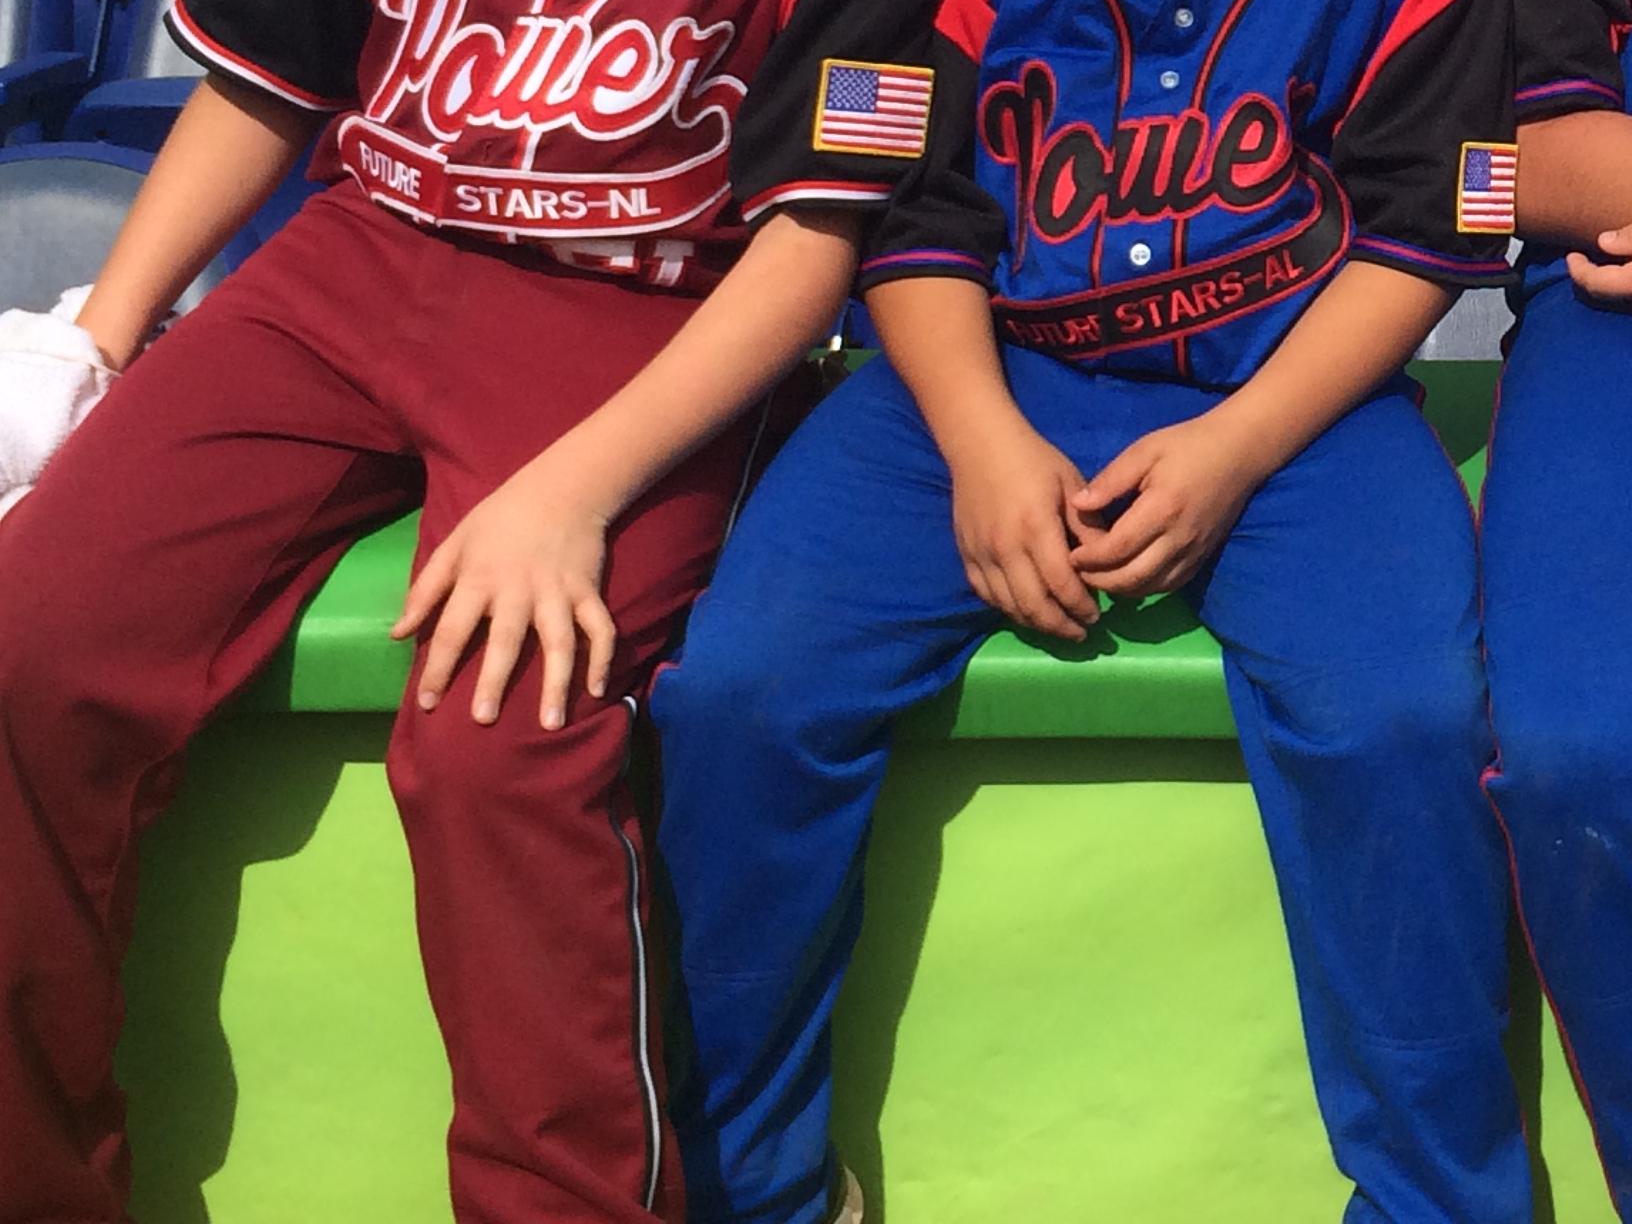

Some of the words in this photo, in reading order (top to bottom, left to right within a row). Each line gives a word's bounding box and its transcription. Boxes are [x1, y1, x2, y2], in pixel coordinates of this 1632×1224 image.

[359, 140, 422, 201] FUTURE
[456, 184, 662, 220] STARS-NL
[1114, 248, 1306, 334] STARS-AL
